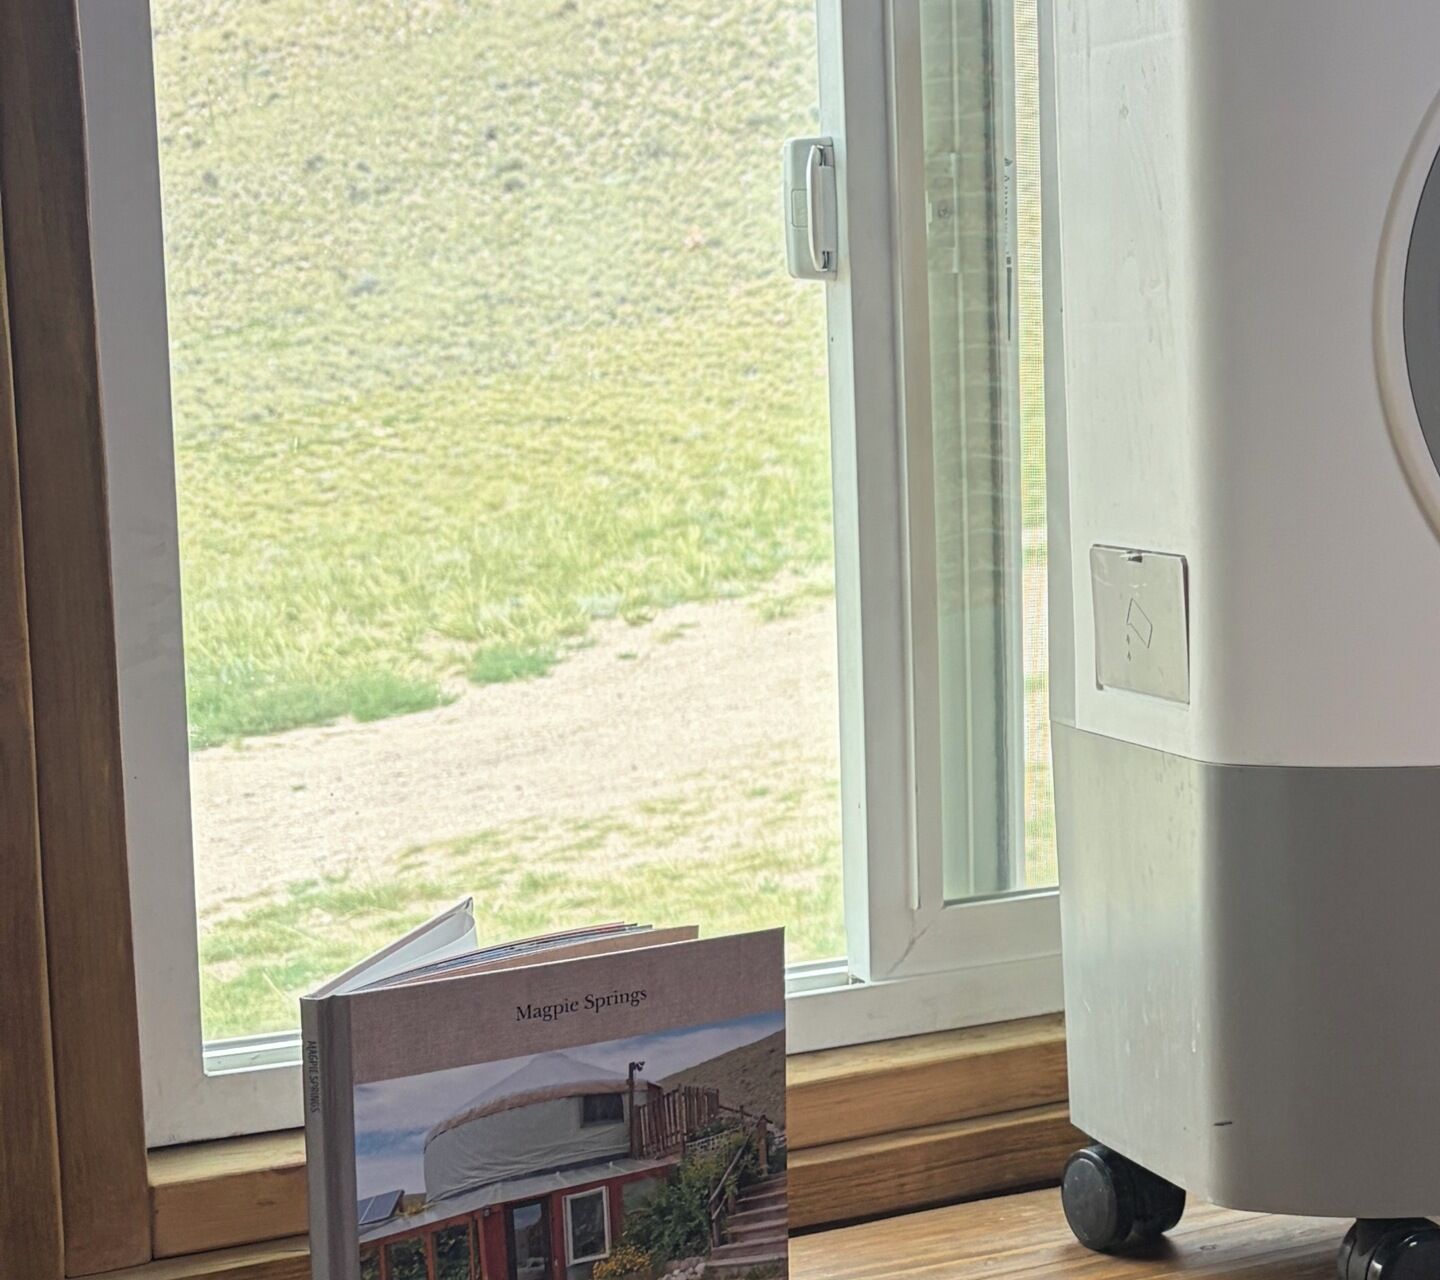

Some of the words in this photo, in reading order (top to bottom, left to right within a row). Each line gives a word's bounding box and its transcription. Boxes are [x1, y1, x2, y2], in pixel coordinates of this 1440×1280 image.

[516, 997, 579, 1022] Magpie
[584, 988, 648, 1014] Springs
[307, 1040, 318, 1074] MAGPIE
[308, 1075, 321, 1113] SPRINGS
